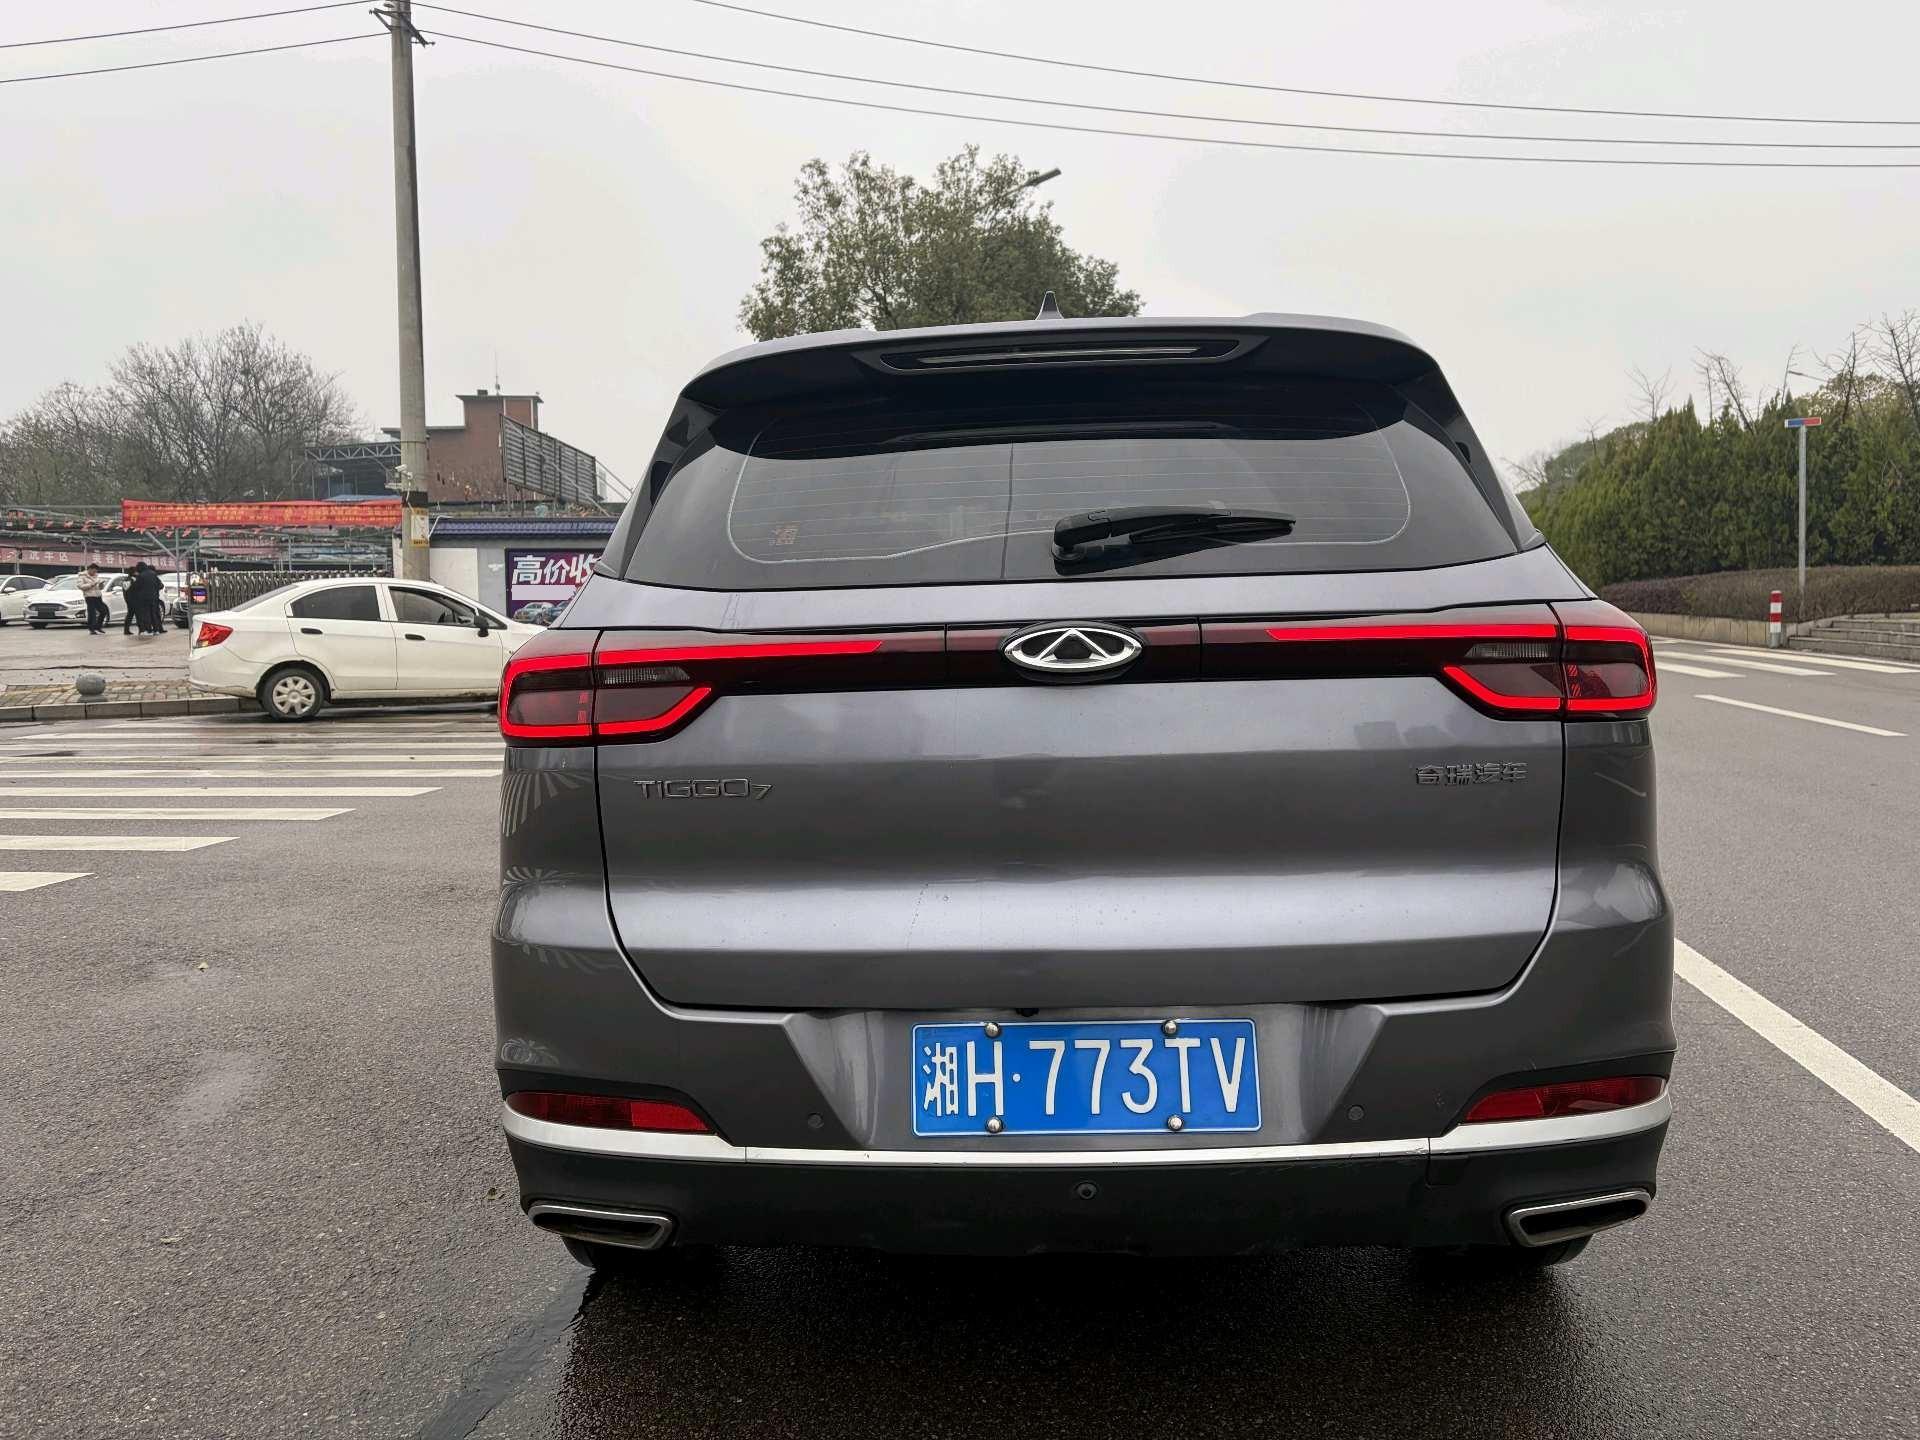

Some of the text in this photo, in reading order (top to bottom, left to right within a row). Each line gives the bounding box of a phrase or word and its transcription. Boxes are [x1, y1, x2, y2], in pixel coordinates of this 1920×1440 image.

[512, 553, 602, 585] 高价收
[1416, 762, 1528, 784] 奇瑞汽车
